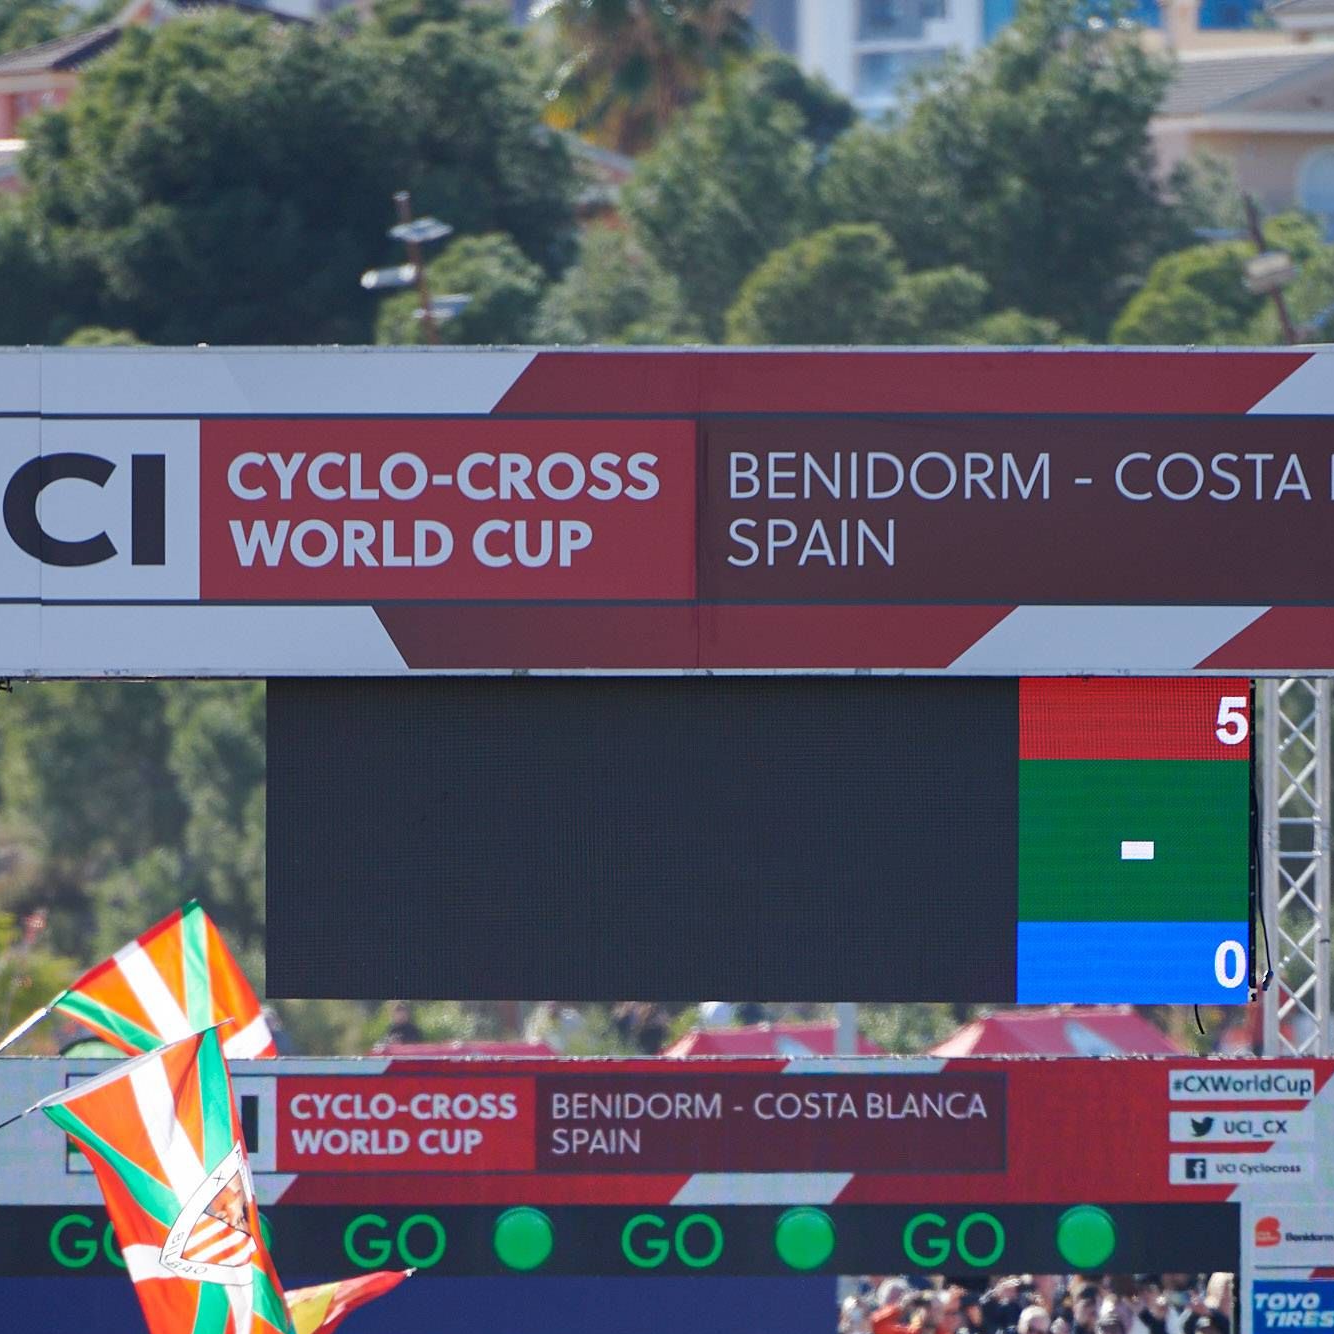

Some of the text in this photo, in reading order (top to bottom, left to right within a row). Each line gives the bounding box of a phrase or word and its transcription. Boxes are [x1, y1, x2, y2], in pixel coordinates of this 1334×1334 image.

[226, 450, 660, 500] CYCLO-CROSS
[727, 450, 1052, 501] BENIDORM
[1114, 451, 1312, 502] COSTA
[228, 518, 593, 567] WORLD CUP
[726, 517, 897, 567] SPAIN
[1215, 696, 1249, 745] 5
[1213, 939, 1247, 988] 0
[1173, 1075, 1312, 1096] #CXWorldCup
[289, 1093, 518, 1120] CYCLO-CROSS
[551, 1092, 723, 1120] BENIDORM
[753, 1092, 858, 1120] COSTA
[866, 1092, 988, 1119] BLANCA
[291, 1128, 484, 1155] WORLD CUP
[551, 1128, 642, 1154] SPAIN
[1223, 1119, 1288, 1138] UCI_CX
[1216, 1163, 1301, 1176] UCI Cyclocross
[343, 1213, 447, 1269] GO
[621, 1213, 724, 1269] GO
[902, 1212, 1006, 1268] GO
[1285, 1232, 1334, 1242] Benidorm
[1254, 1292, 1321, 1311] TOYO
